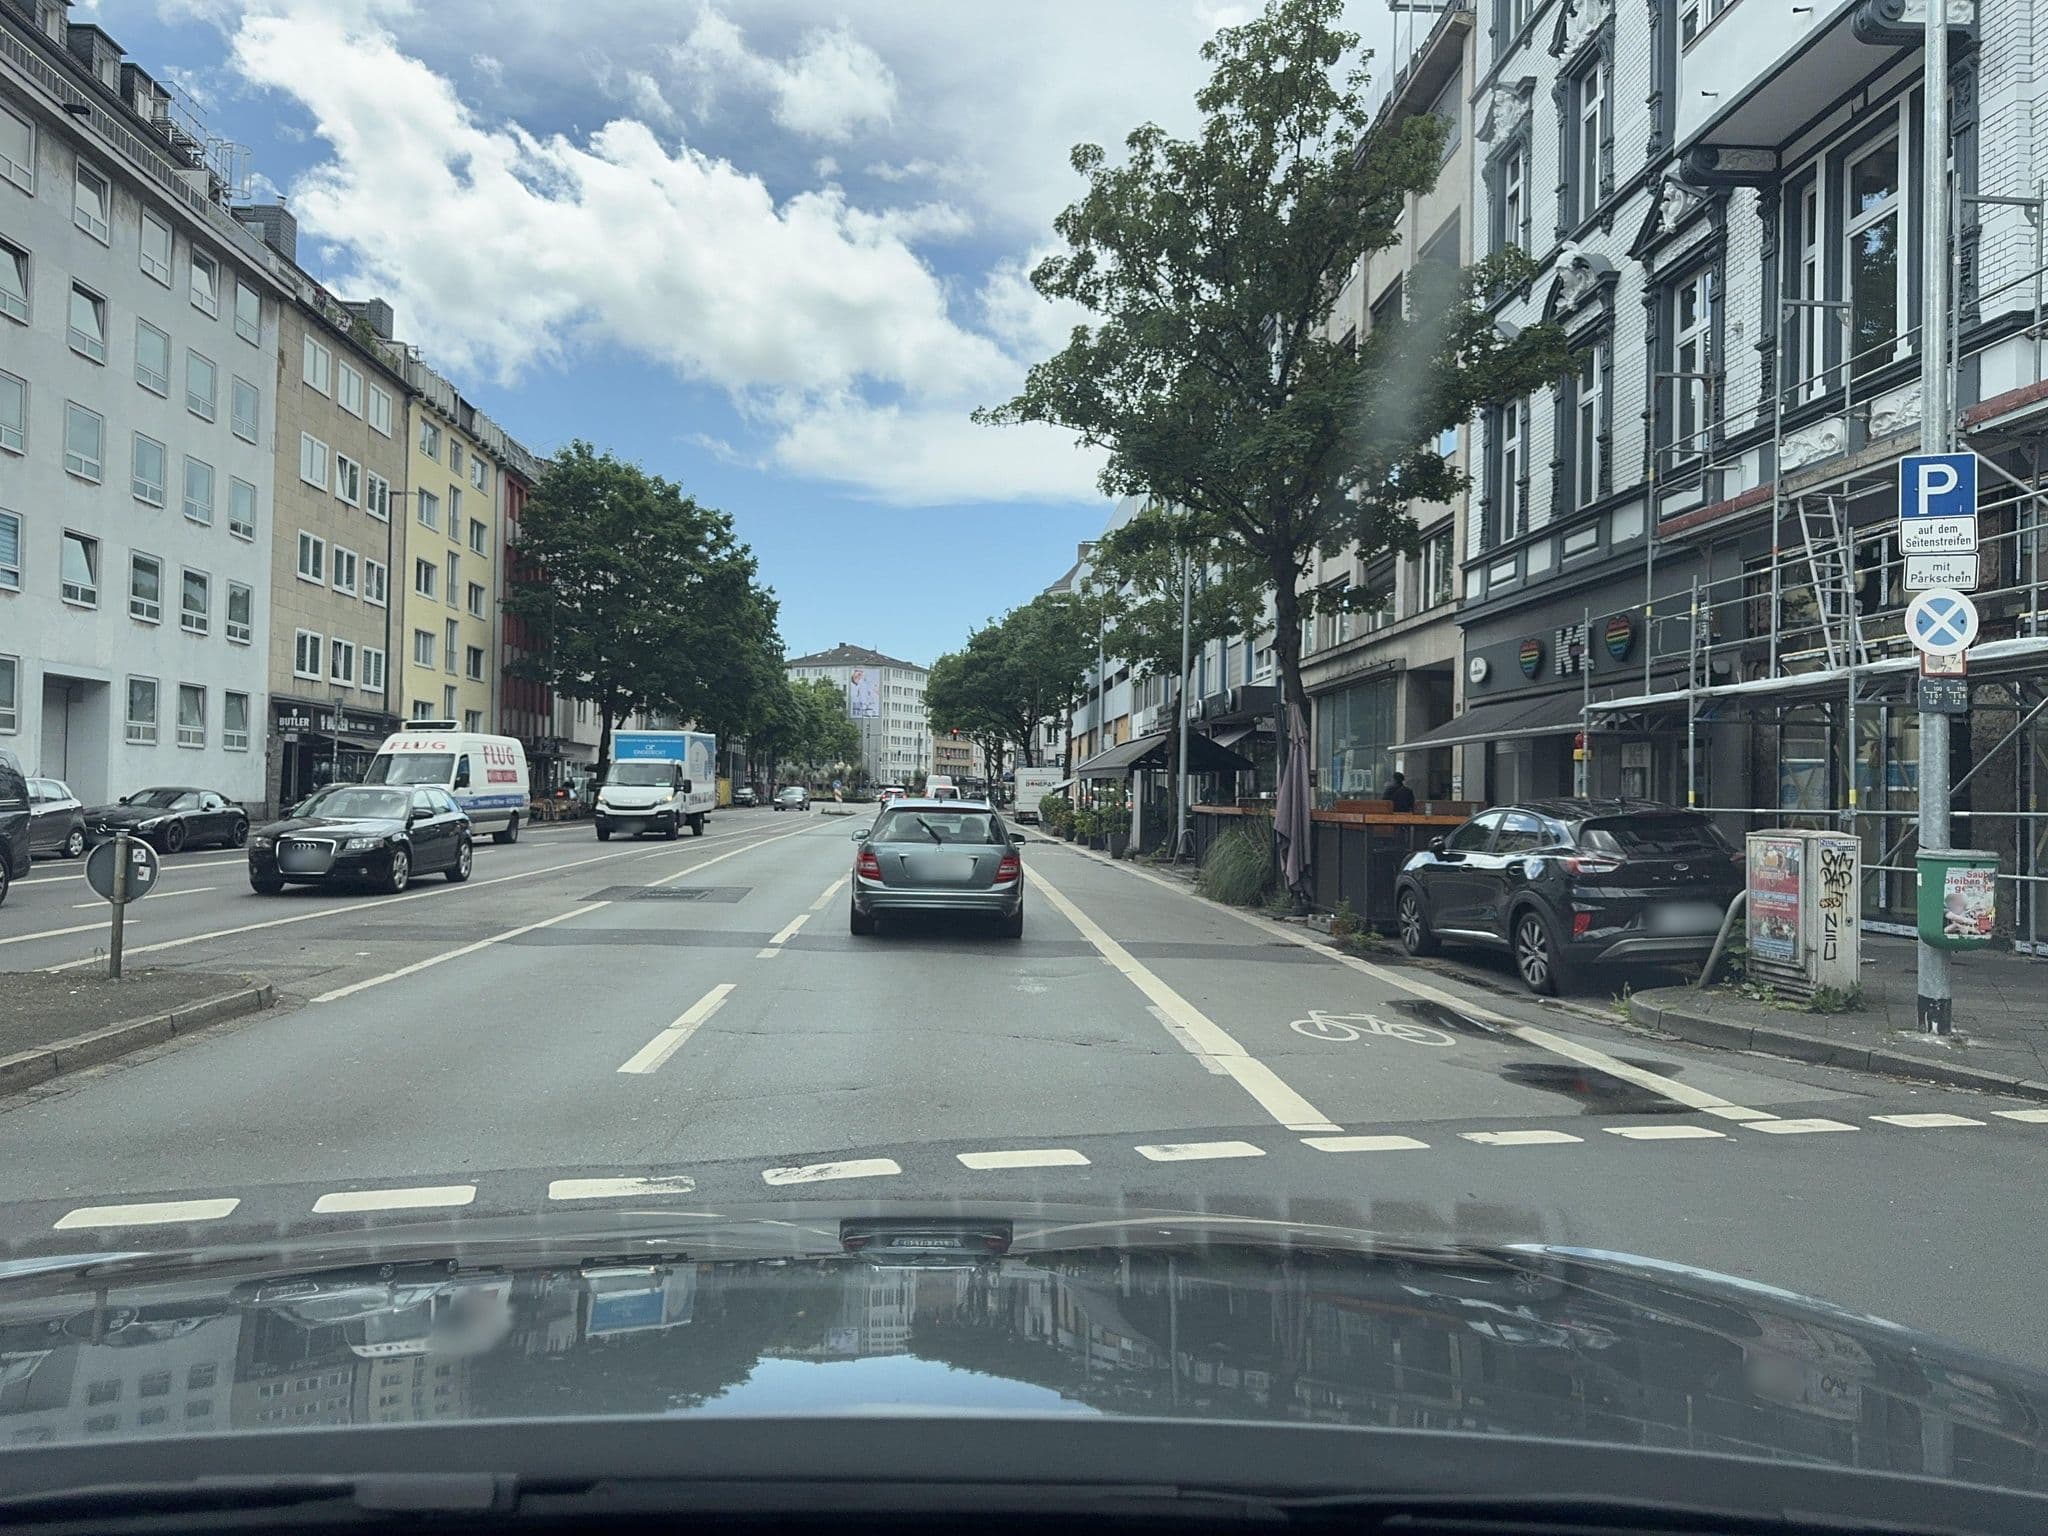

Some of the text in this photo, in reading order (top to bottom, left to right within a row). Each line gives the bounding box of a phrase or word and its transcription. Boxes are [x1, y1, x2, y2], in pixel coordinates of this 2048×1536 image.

[1918, 463, 1959, 515] P
[1918, 524, 1958, 535] auf dem
[1905, 535, 1972, 548] Seitenstreifen
[1932, 562, 1950, 571] mit
[1910, 573, 1971, 583] Parkschein
[279, 717, 310, 727] BUTLER
[388, 741, 447, 750] FLUG
[482, 744, 515, 765] FLUG
